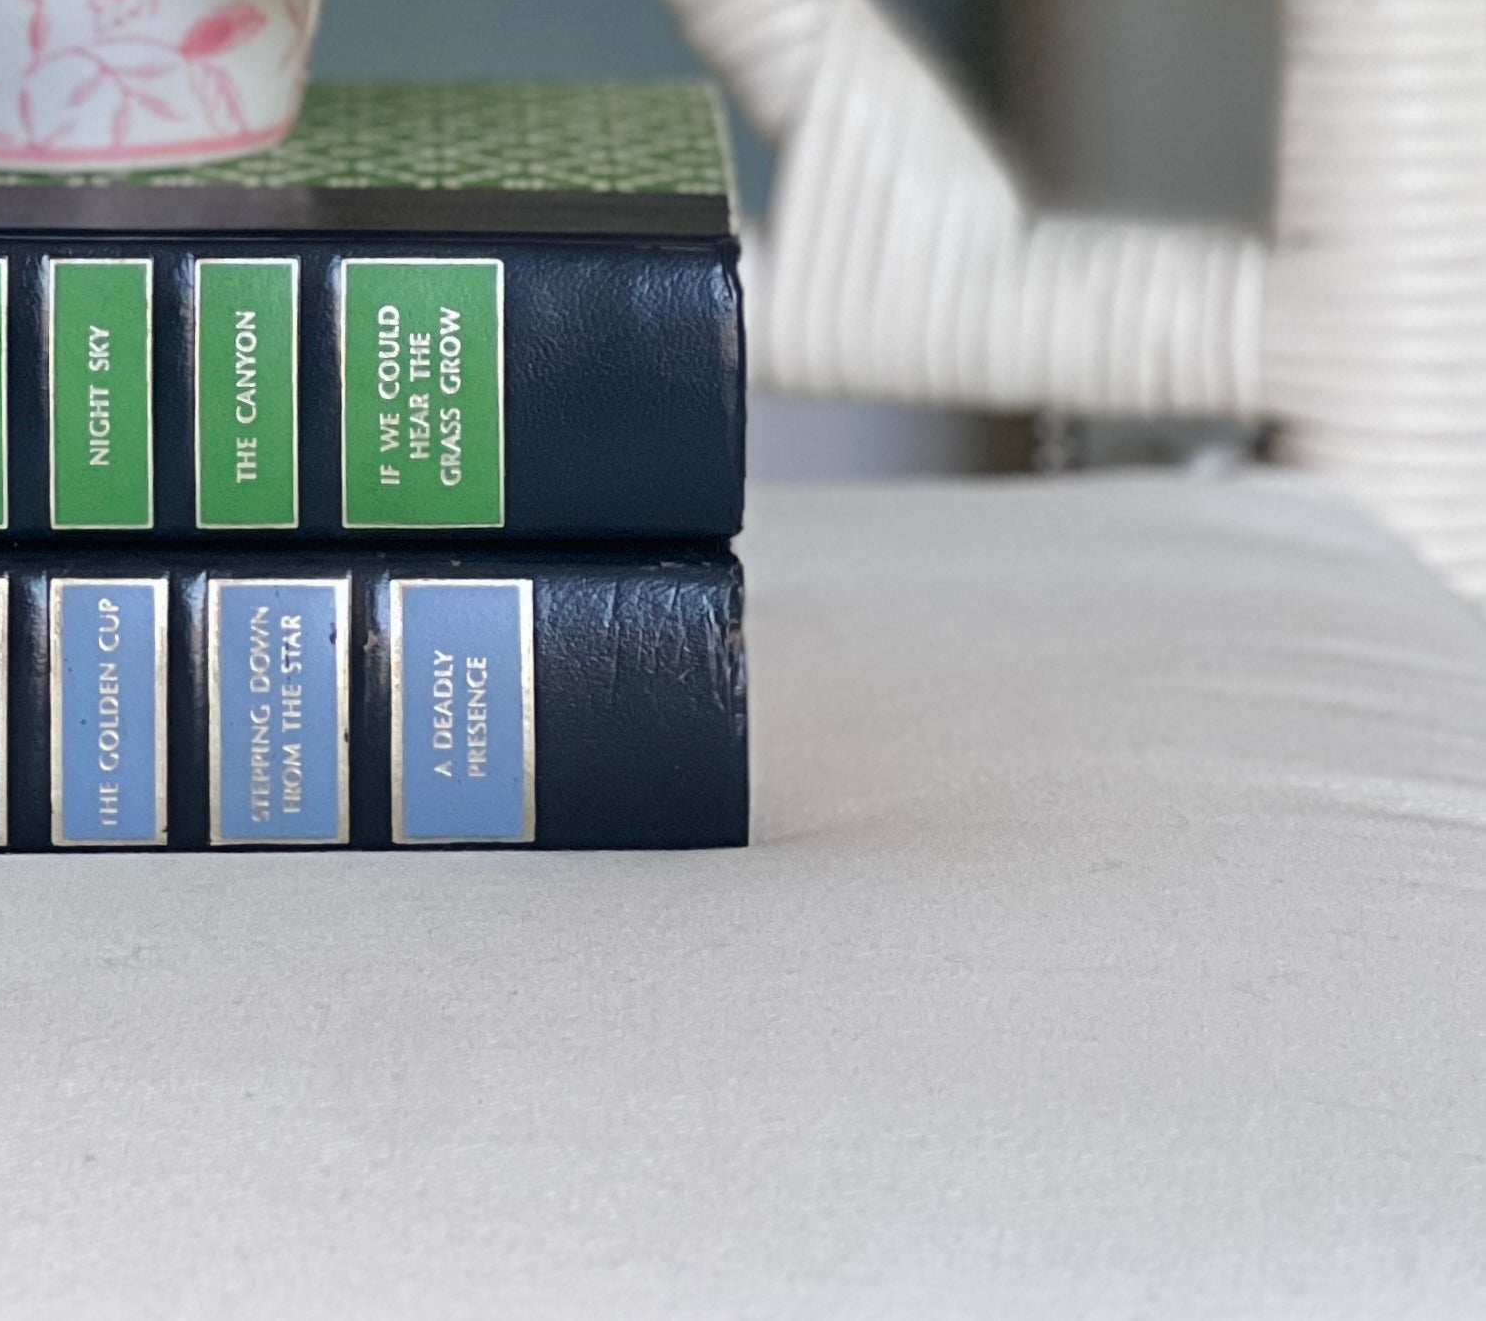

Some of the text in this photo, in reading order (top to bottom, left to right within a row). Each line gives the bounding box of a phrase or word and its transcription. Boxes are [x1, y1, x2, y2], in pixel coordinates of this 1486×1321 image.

[88, 324, 110, 466] NIGHT SKY
[235, 310, 257, 483] THE CANYON
[377, 304, 401, 485] IF WE COULD
[409, 331, 431, 459] HEAR THE
[439, 306, 462, 487] GRASS GROW
[97, 597, 120, 825] THE GOLDEN CUP
[249, 606, 270, 824] STEPPING DOWN
[280, 614, 302, 814] FROM THE STAR
[432, 649, 454, 777] A DEADLY
[465, 656, 487, 778] PRESENCE
